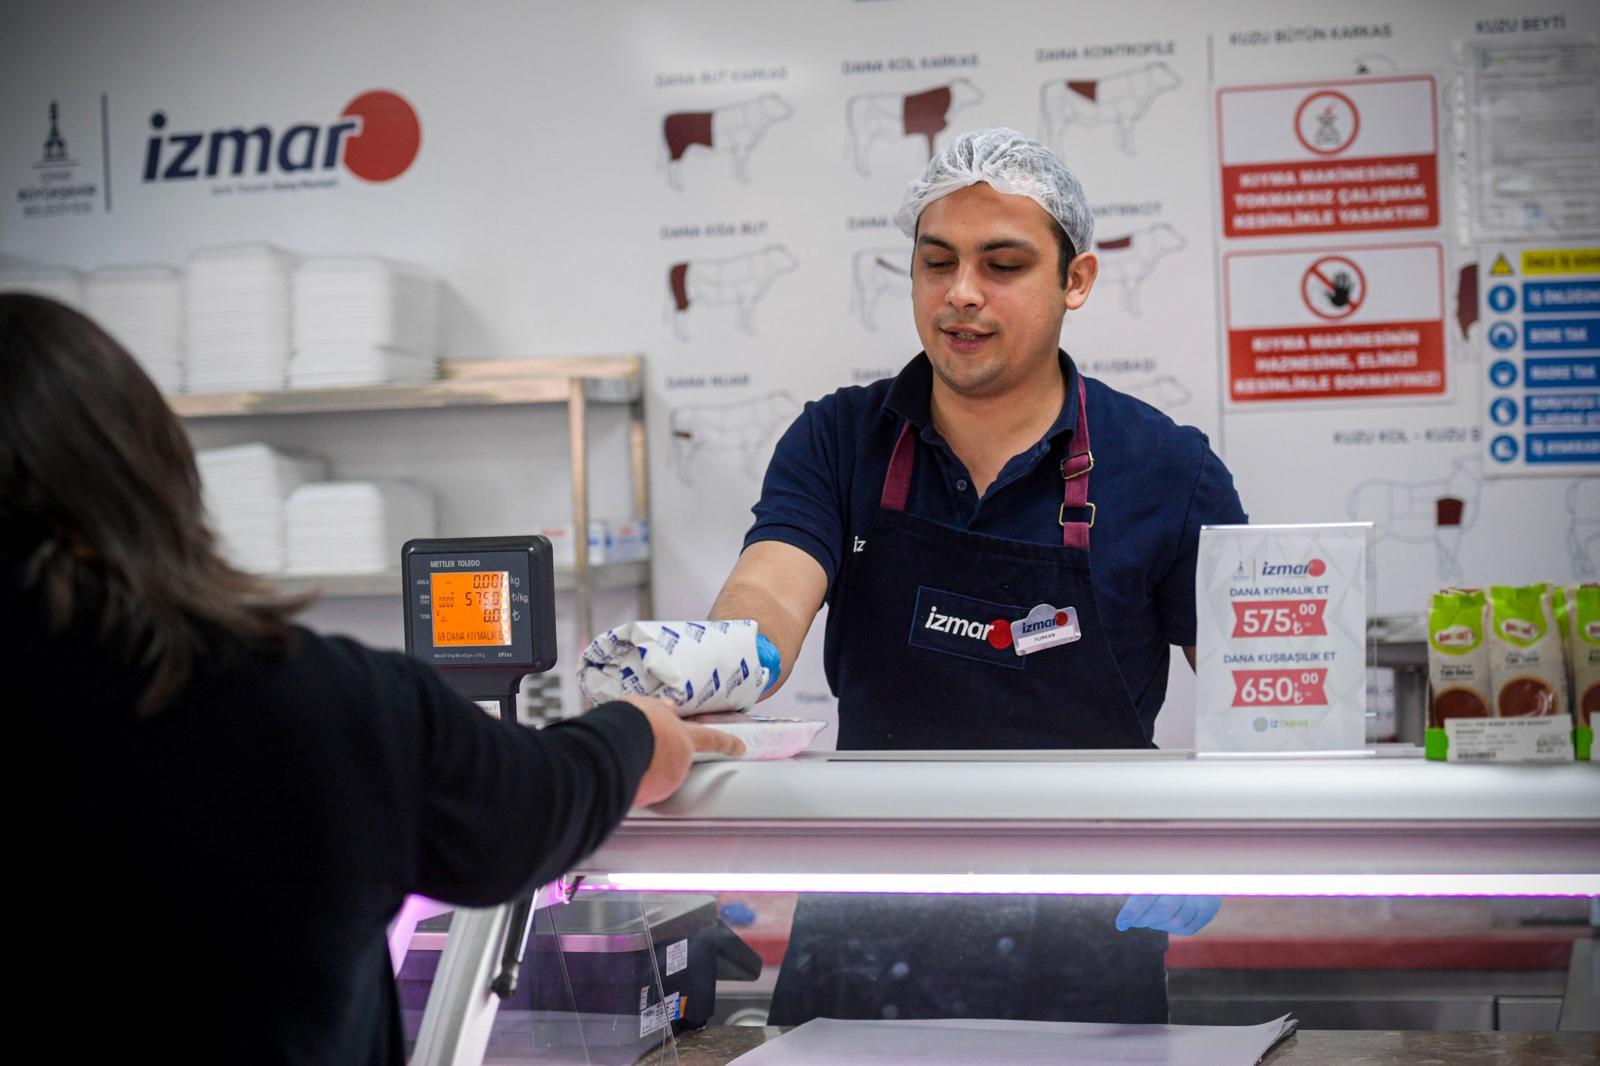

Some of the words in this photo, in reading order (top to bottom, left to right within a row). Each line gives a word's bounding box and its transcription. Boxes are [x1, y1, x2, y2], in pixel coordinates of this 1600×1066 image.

[143, 112, 356, 182] izmar
[431, 560, 455, 568] METTLER
[1262, 561, 1311, 576] izmar
[1230, 588, 1260, 597] DANA
[1264, 586, 1314, 596] KIYMALIK
[1317, 585, 1329, 595] ET
[925, 606, 995, 641] izmar
[1022, 615, 1057, 634] izmar
[446, 632, 465, 641] DANA
[1034, 633, 1056, 642] FURKAN
[1224, 654, 1255, 664] DANA
[1258, 652, 1320, 663] KUŞBAŞILIK
[1324, 651, 1336, 661] ET
